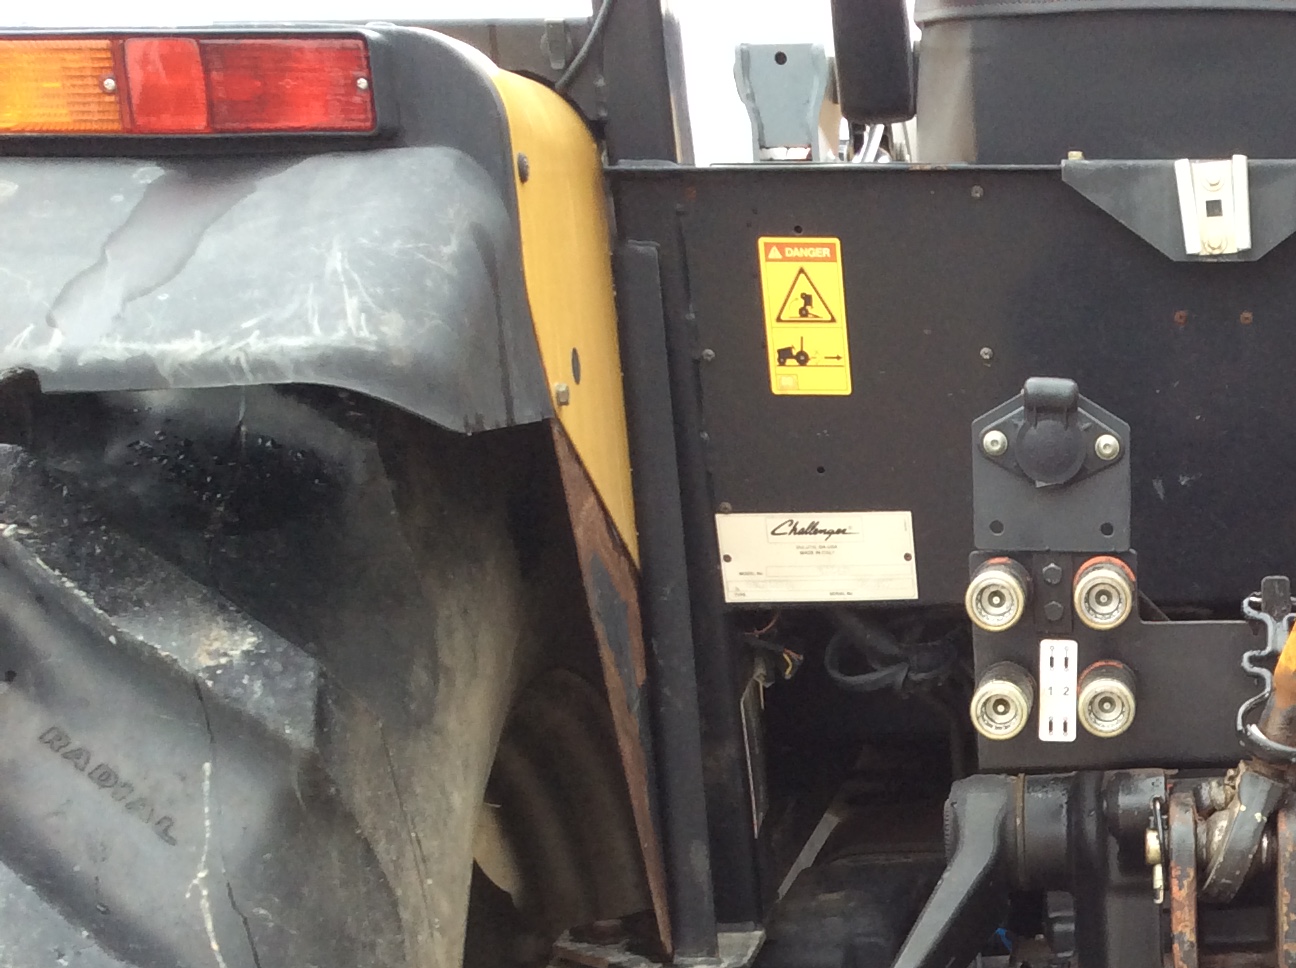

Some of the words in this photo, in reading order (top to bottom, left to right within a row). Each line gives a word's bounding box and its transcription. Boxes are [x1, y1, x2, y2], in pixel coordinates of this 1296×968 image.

[785, 247, 830, 258] DANGER
[770, 518, 859, 542] Challenger
[1063, 686, 1070, 696] 2
